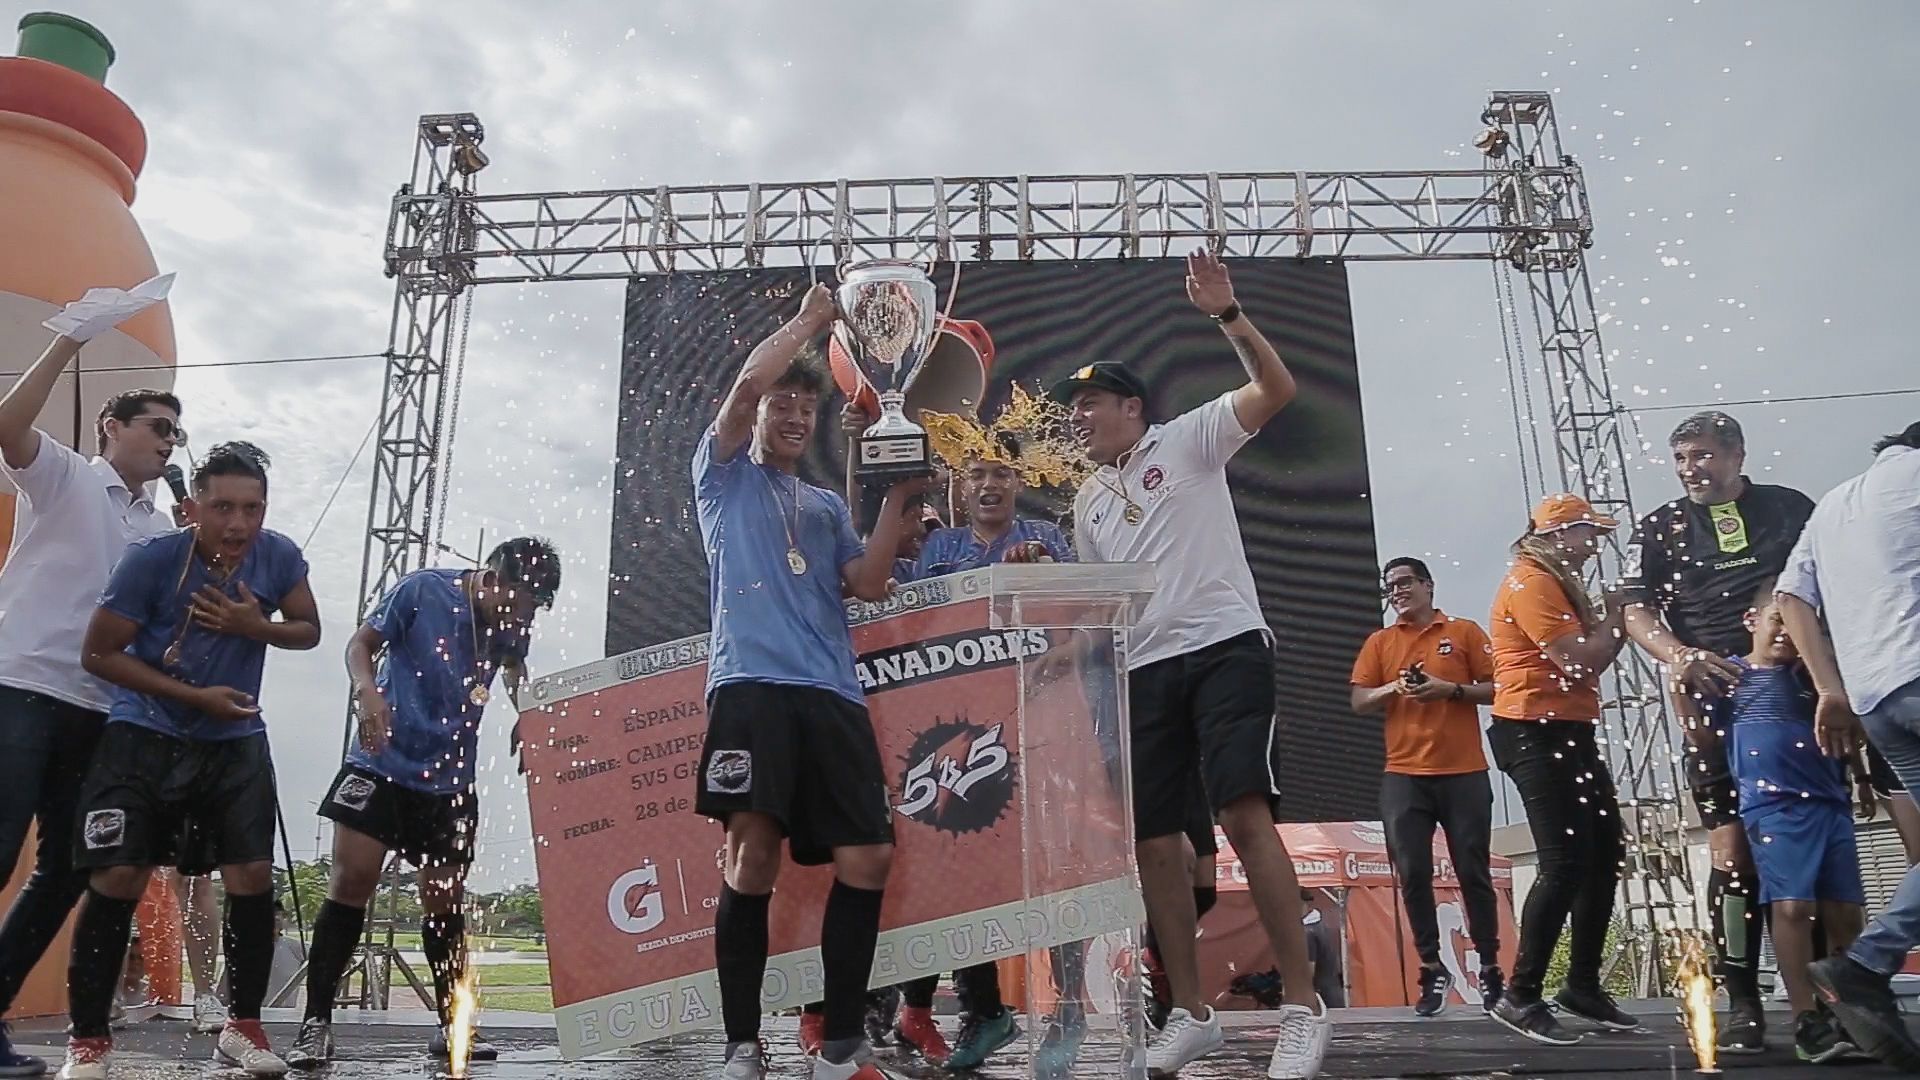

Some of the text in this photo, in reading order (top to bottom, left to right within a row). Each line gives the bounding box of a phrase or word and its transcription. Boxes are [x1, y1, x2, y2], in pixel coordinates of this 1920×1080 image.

[1713, 557, 1757, 570] DIADORA
[855, 628, 1049, 689] ANADORES
[623, 701, 704, 733] ESPAÑA
[557, 758, 621, 784] NOMBRE:
[631, 768, 667, 790] 5V5
[563, 797, 689, 840] FECHA: 28 de
[608, 864, 664, 934] G
[576, 959, 824, 1048] ECUAOR
[872, 896, 1127, 979] ECUADOR
